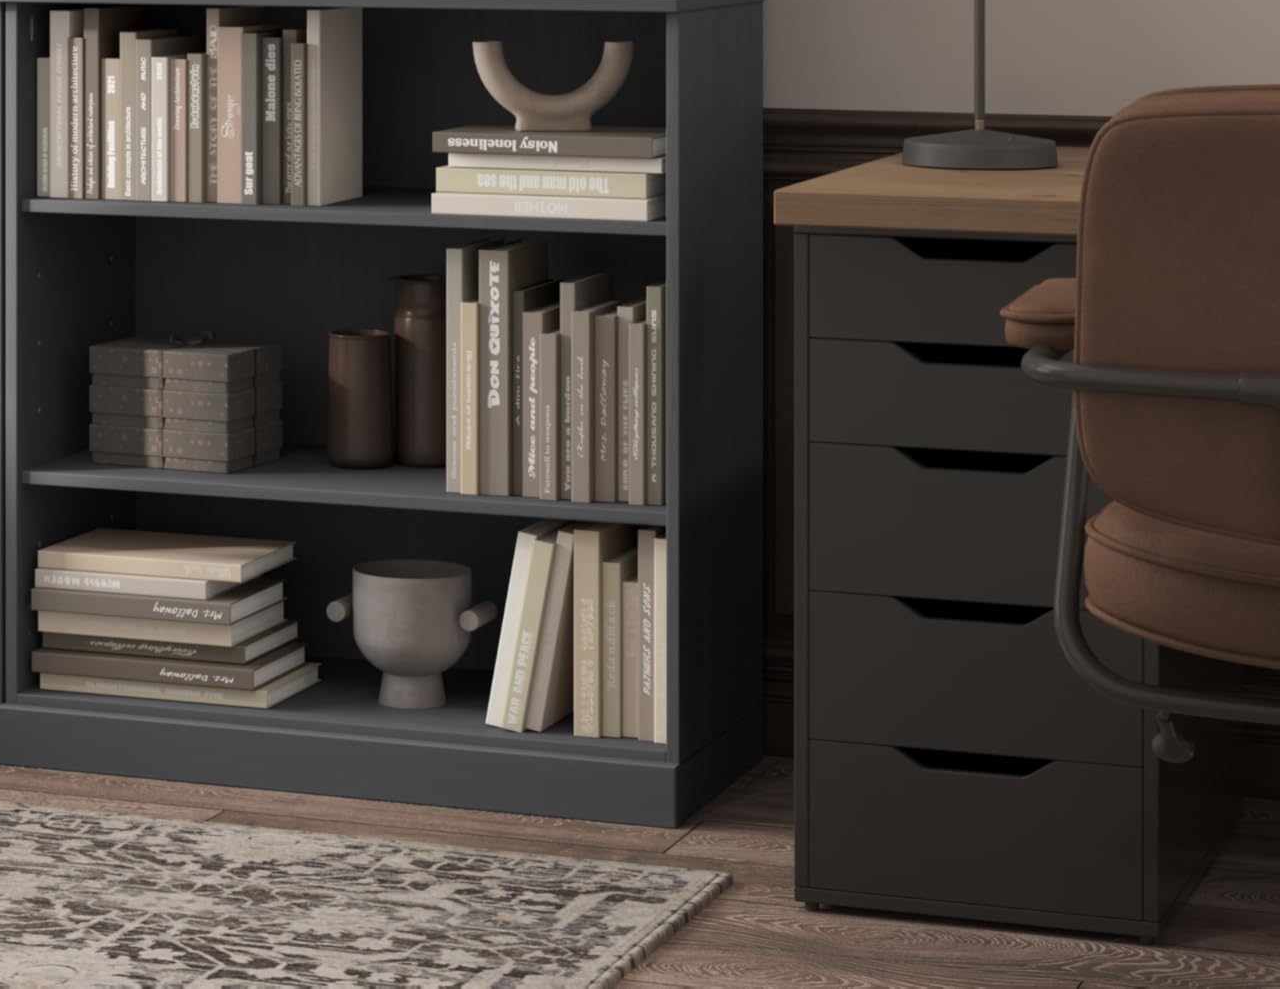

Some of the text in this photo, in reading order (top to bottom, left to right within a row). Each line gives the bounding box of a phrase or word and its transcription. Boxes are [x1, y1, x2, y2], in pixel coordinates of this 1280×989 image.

[208, 67, 218, 87] THE
[265, 43, 276, 122] Malone dies
[293, 59, 303, 97] ISOLATED
[70, 44, 80, 191] History of modern architecture
[208, 95, 218, 110] OF
[293, 97, 303, 121] BEING
[208, 117, 218, 156] STORY
[448, 137, 559, 153] Noisy loneliness
[208, 162, 218, 186] THE
[293, 134, 303, 187] ADVANTAGES
[476, 172, 609, 194] The old man and the sea
[487, 259, 502, 409] DON QUIXOTE
[527, 337, 538, 479] Mice and people
[600, 358, 609, 426] Dalloway
[153, 601, 223, 621] Mrs. Dalloway
[642, 582, 652, 696] FATHERS AND SONS
[159, 667, 235, 685] Mrs. Dalloway
[507, 630, 530, 725] WAR AND PEACE
